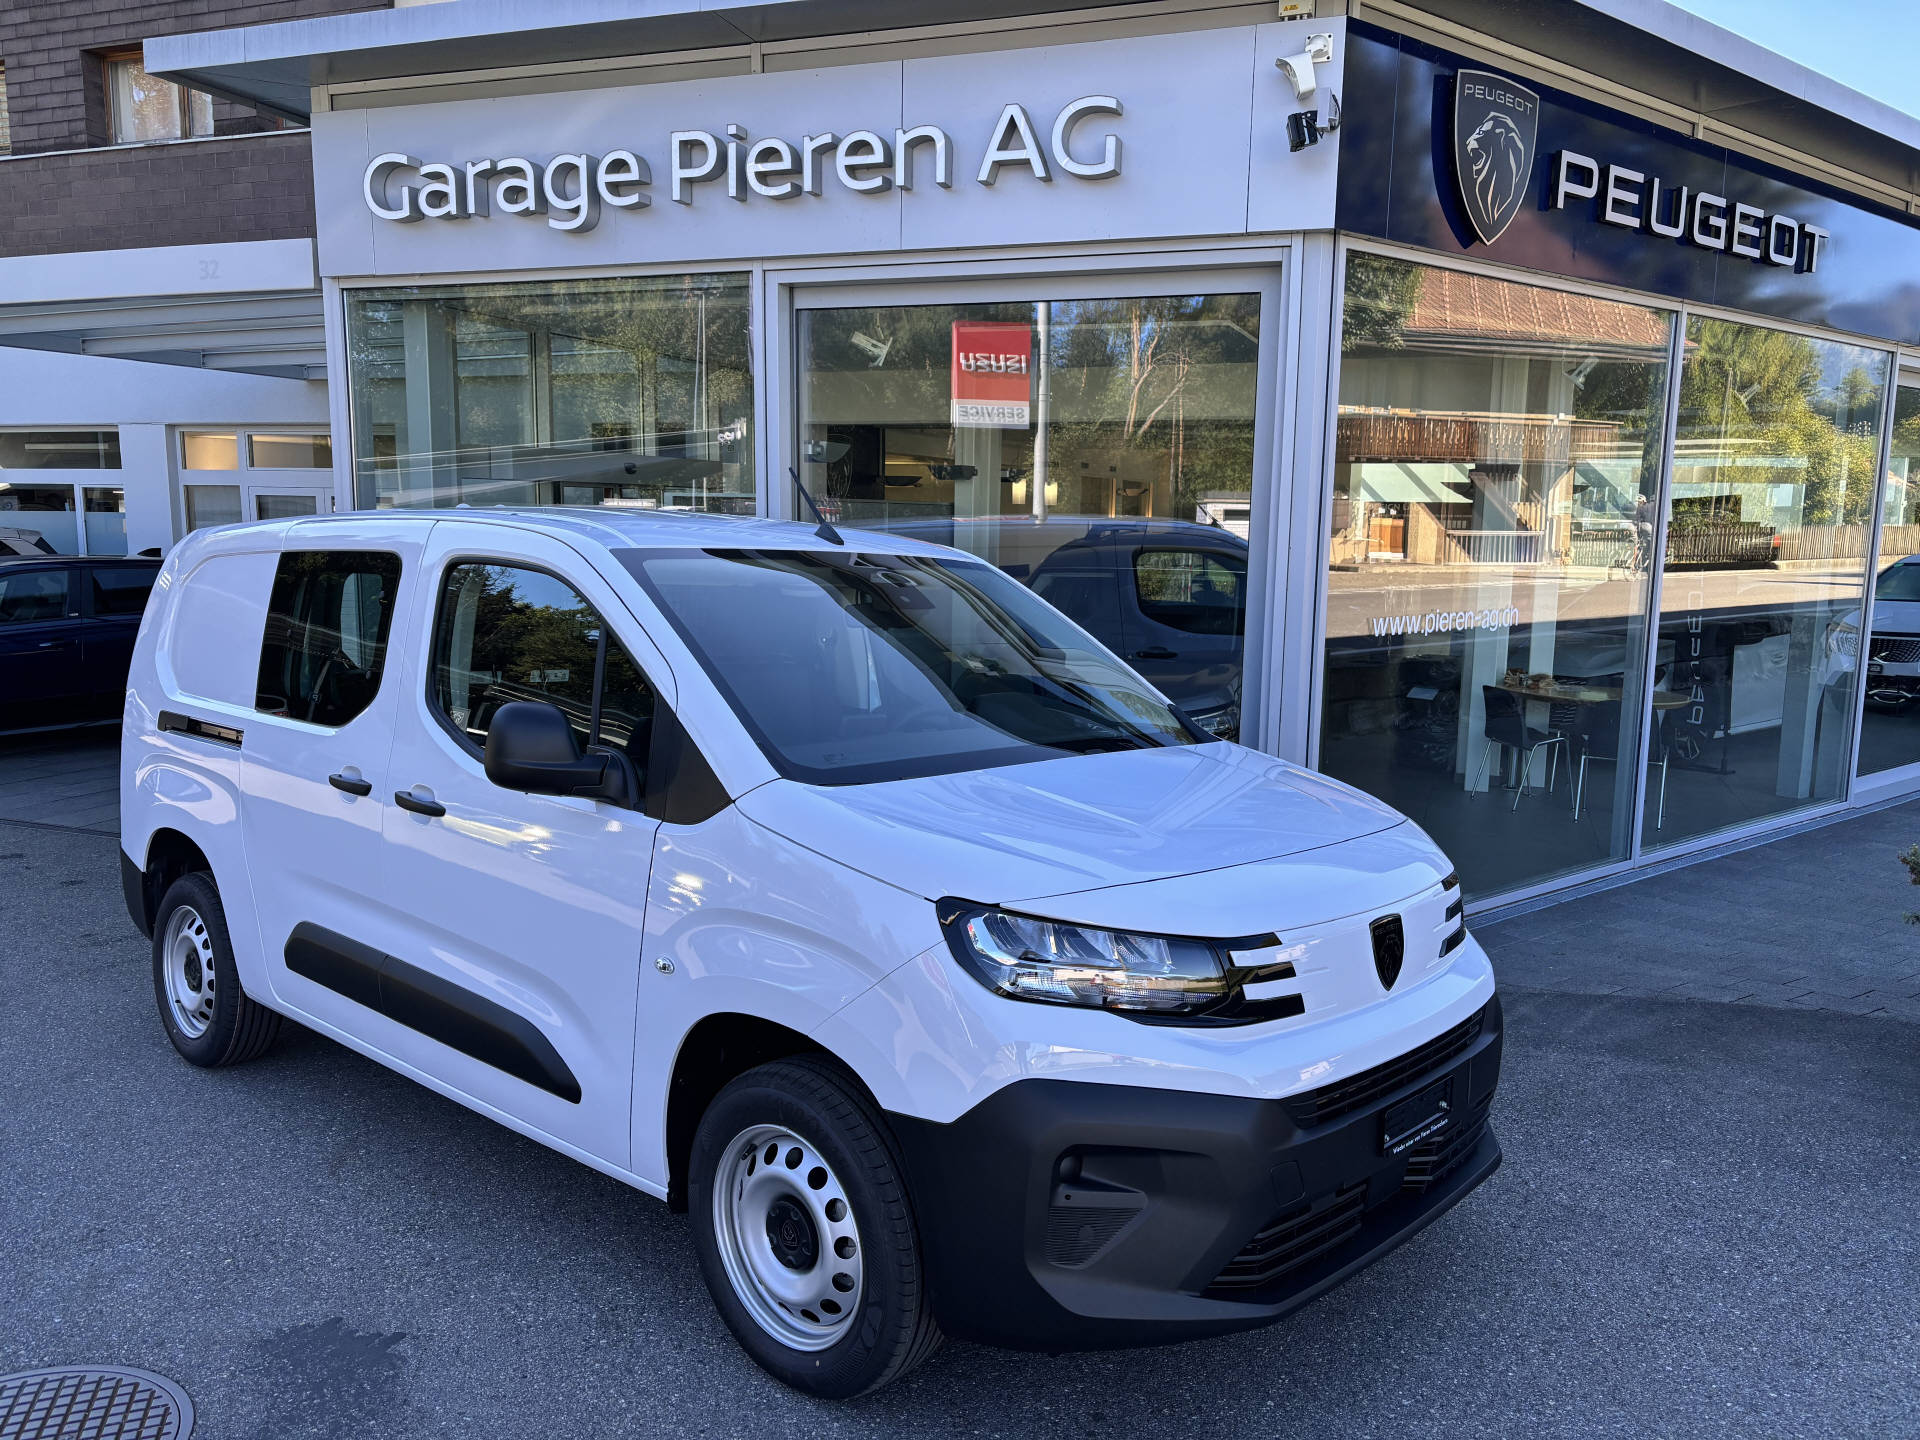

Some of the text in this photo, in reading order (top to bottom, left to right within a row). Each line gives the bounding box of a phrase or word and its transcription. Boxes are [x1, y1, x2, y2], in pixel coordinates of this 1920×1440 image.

[1464, 83, 1533, 115] PEUGEOT
[363, 95, 1123, 232] Garage Pieren AG
[1556, 149, 1830, 274] PEUGEOT
[198, 260, 220, 280] 32
[1372, 604, 1520, 637] www.pieren-ag.ch
